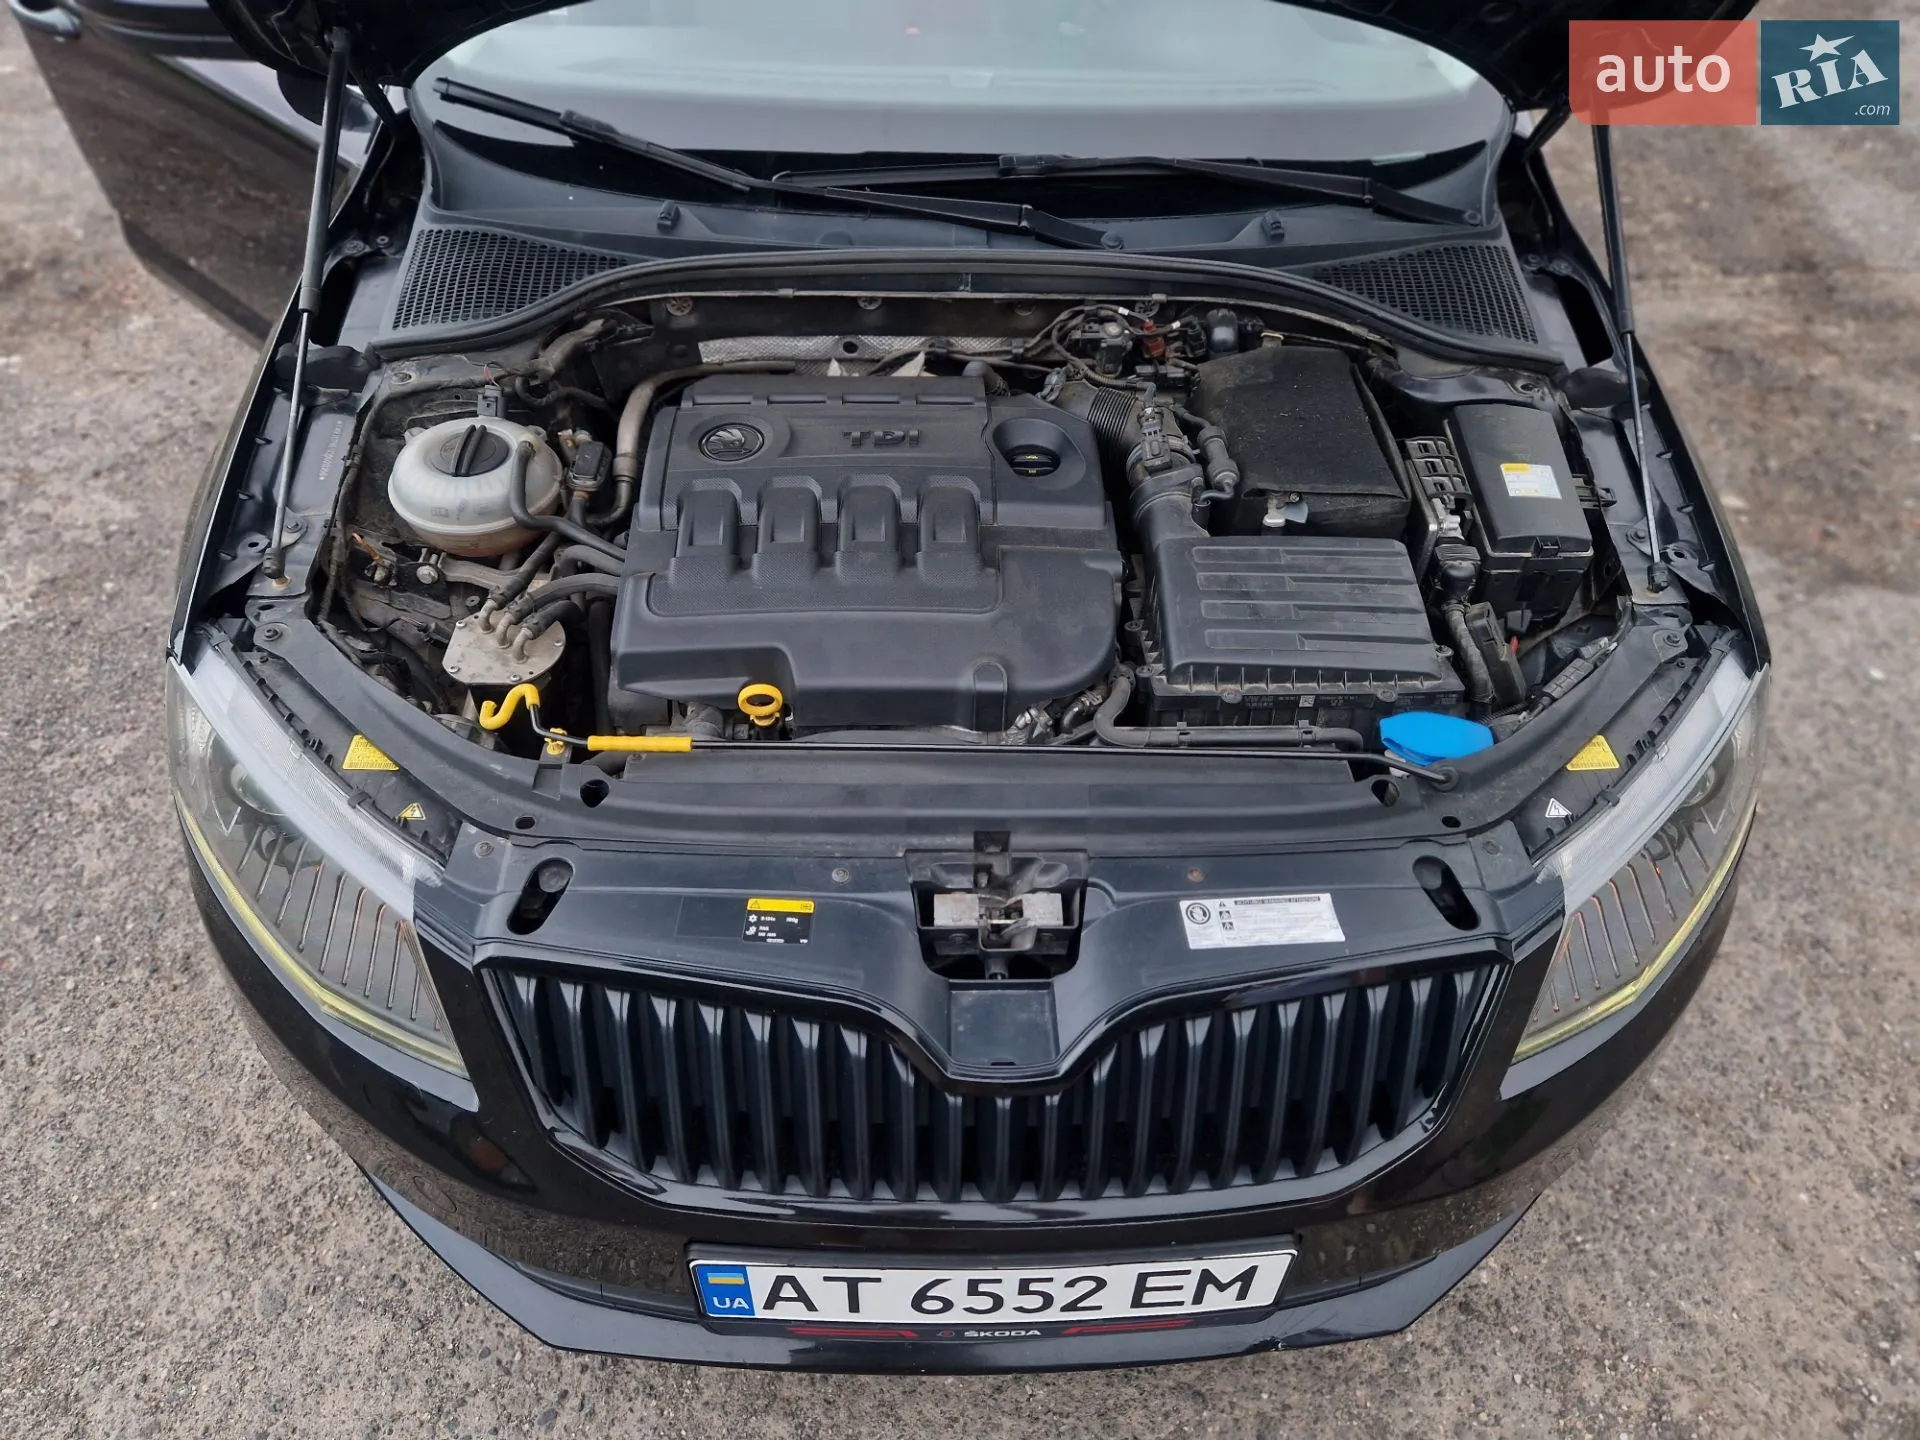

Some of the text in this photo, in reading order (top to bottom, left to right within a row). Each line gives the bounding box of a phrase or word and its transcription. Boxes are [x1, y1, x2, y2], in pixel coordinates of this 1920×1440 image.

[842, 429, 920, 447] TDI
[762, 1264, 1259, 1315] AT 6552 EM
[712, 1296, 750, 1311] UA
